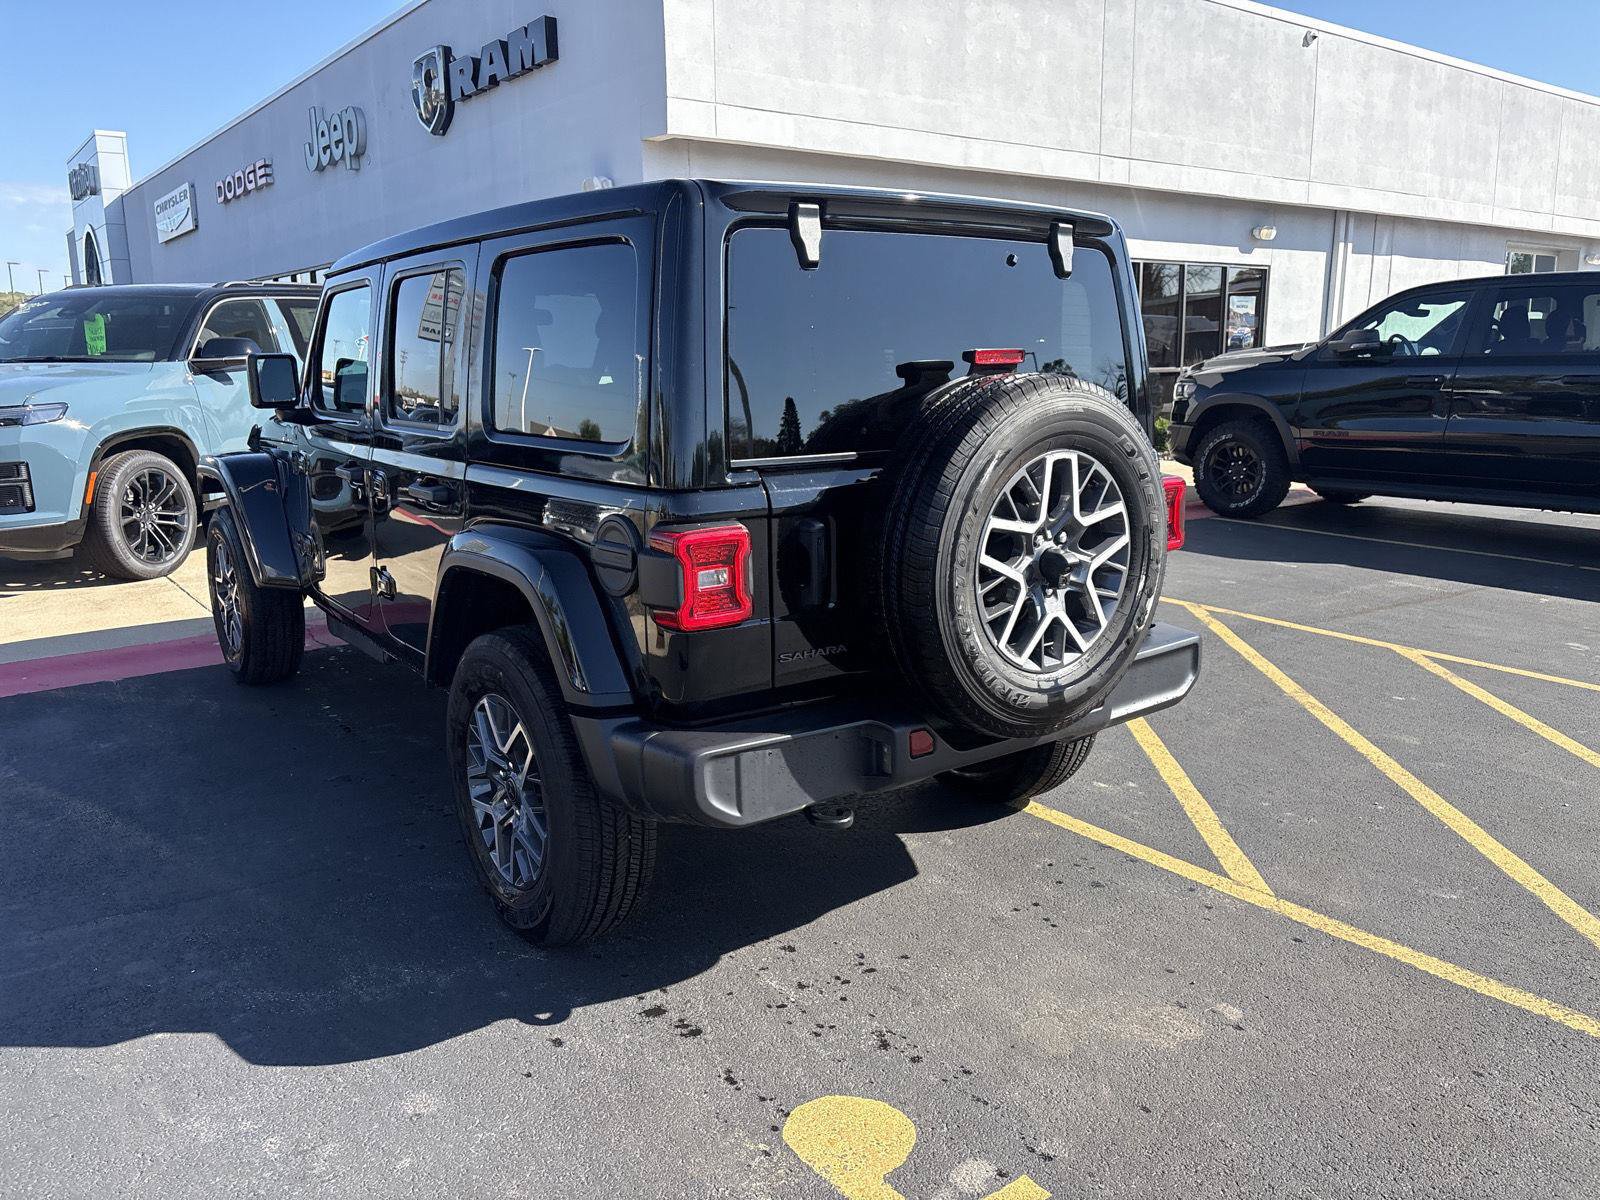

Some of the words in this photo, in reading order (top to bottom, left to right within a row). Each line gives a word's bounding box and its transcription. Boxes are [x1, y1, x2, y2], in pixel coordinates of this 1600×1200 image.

[449, 15, 558, 102] RAM
[304, 106, 366, 172] Jeep
[155, 188, 188, 215] CHRYSLER
[215, 158, 273, 204] DODGE
[778, 644, 848, 663] SAHARA
